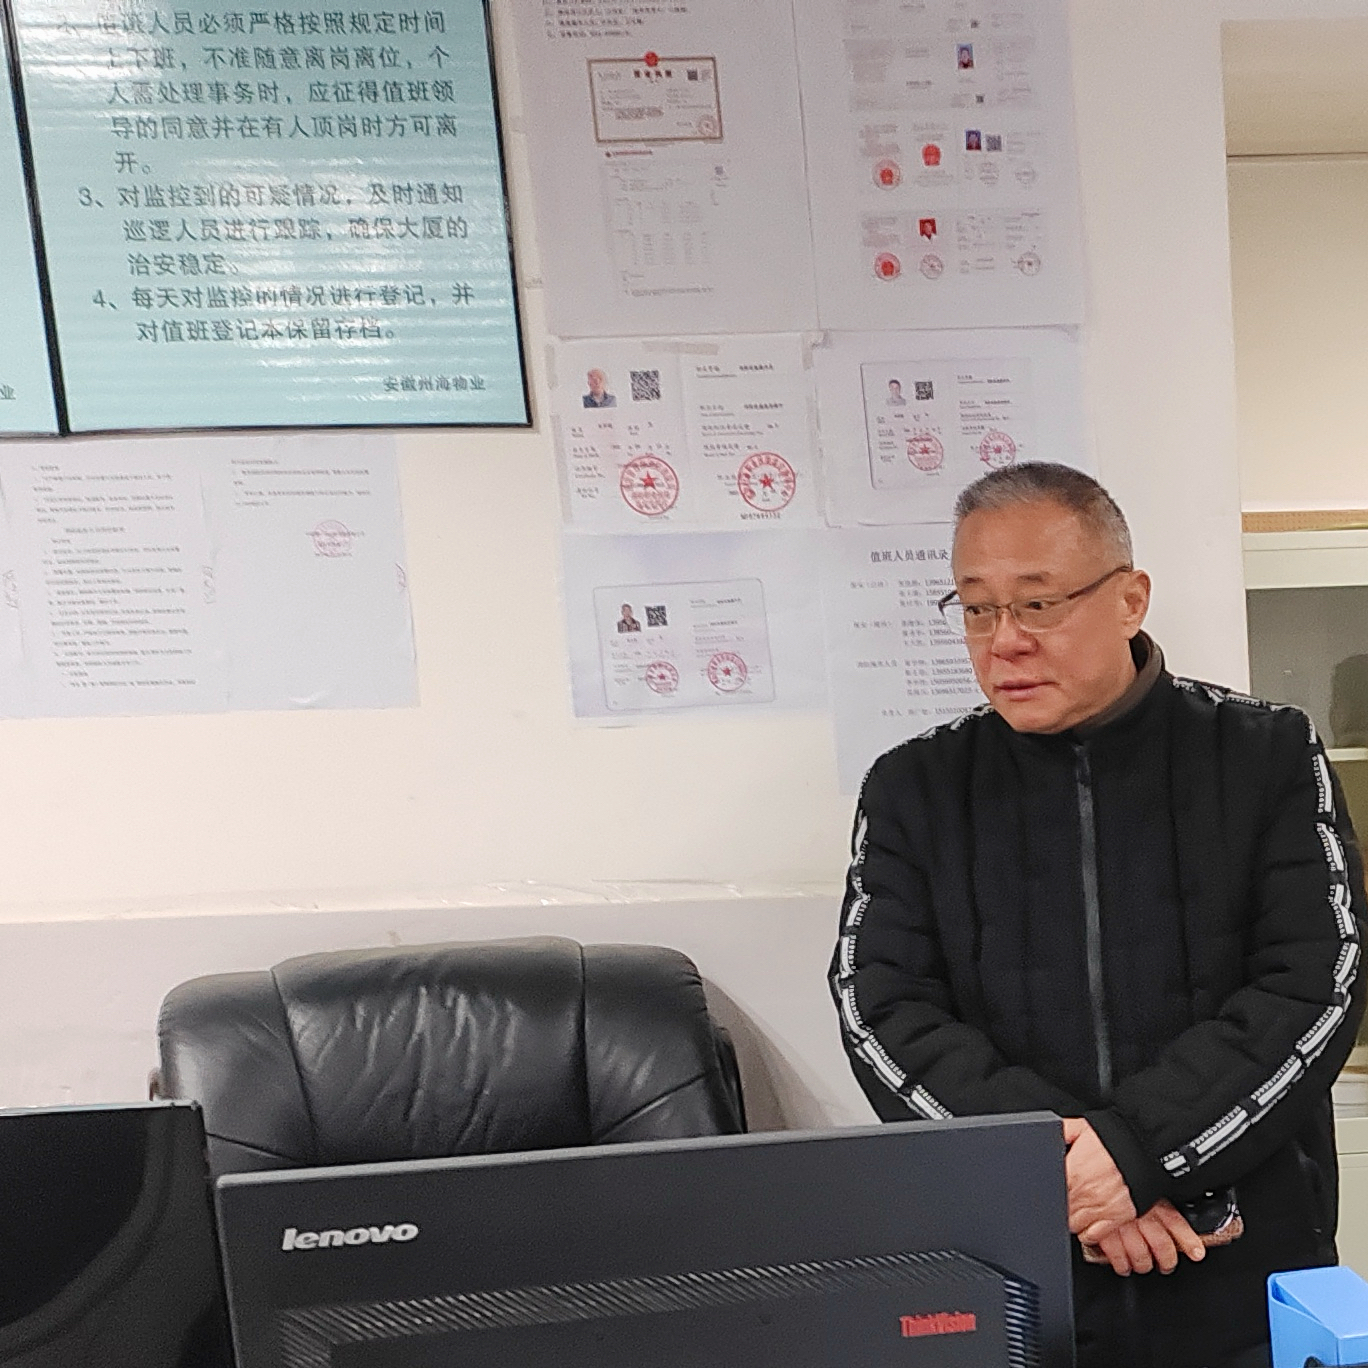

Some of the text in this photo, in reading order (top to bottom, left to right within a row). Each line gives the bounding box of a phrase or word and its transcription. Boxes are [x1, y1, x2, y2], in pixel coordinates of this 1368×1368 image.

[110, 114, 458, 140] 导的同意并在有人顶岗时方可离
[282, 1223, 419, 1250] lenovo
